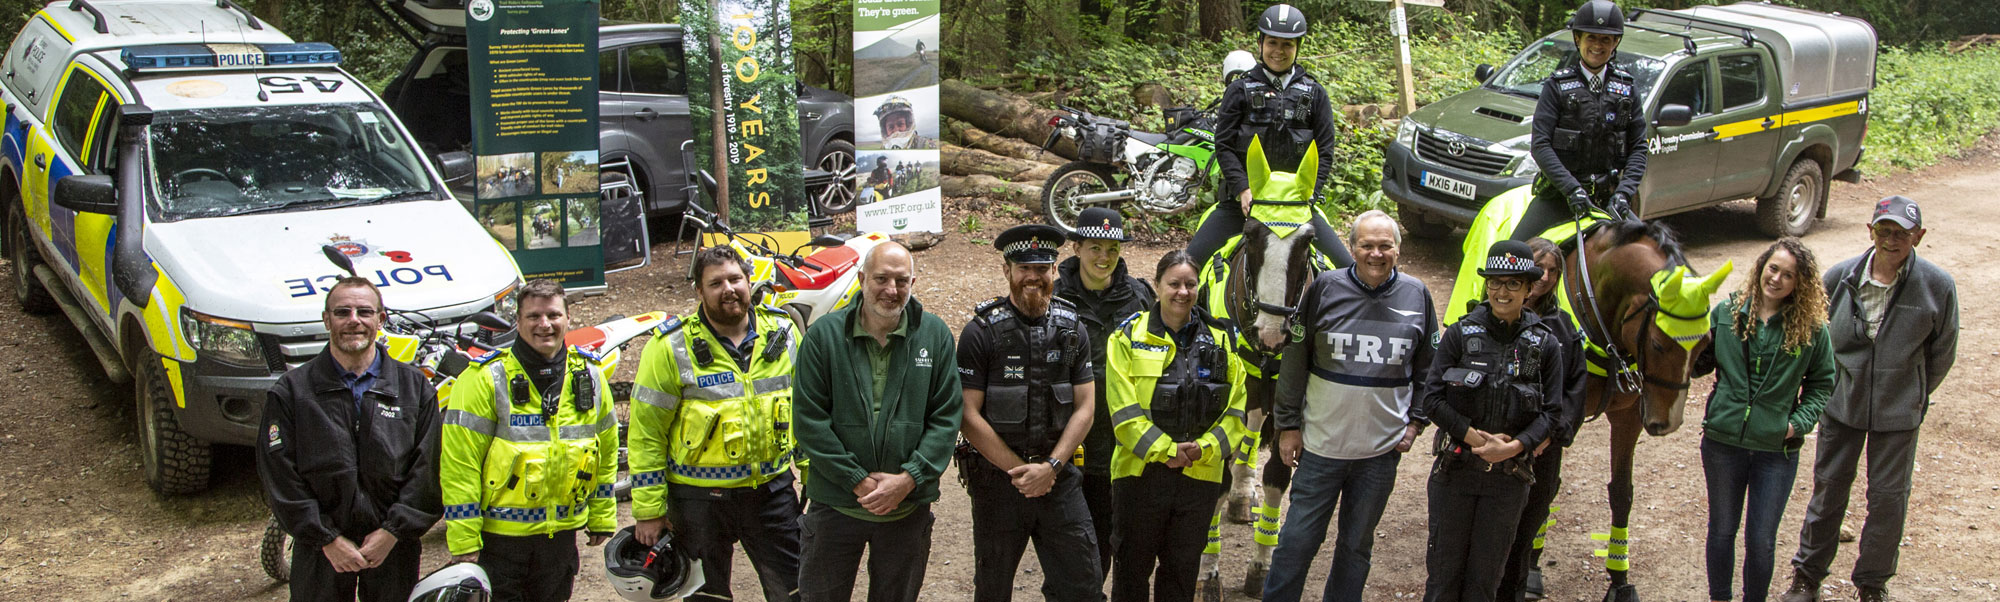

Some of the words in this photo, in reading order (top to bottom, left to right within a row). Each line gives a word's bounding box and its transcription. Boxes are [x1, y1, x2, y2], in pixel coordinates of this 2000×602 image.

[858, 7, 891, 18] They're
[892, 7, 920, 18] green.
[731, 12, 760, 83] 100
[219, 54, 262, 66] POLICE
[721, 63, 731, 74] of
[258, 76, 343, 94] 45
[722, 74, 734, 111] forestry
[727, 113, 737, 133] 1919
[1661, 135, 1679, 144] Forestry
[1679, 131, 1705, 142] Commission
[730, 142, 740, 164] 2019
[740, 94, 770, 208] YEARS
[1661, 144, 1678, 154] England
[1428, 175, 1450, 190] MX16
[1452, 182, 1472, 196] AMU
[864, 200, 936, 218] www.TRF.org.uk
[1328, 332, 1412, 365] TRF
[699, 372, 734, 386] POLICE
[511, 415, 544, 425] POLICE
